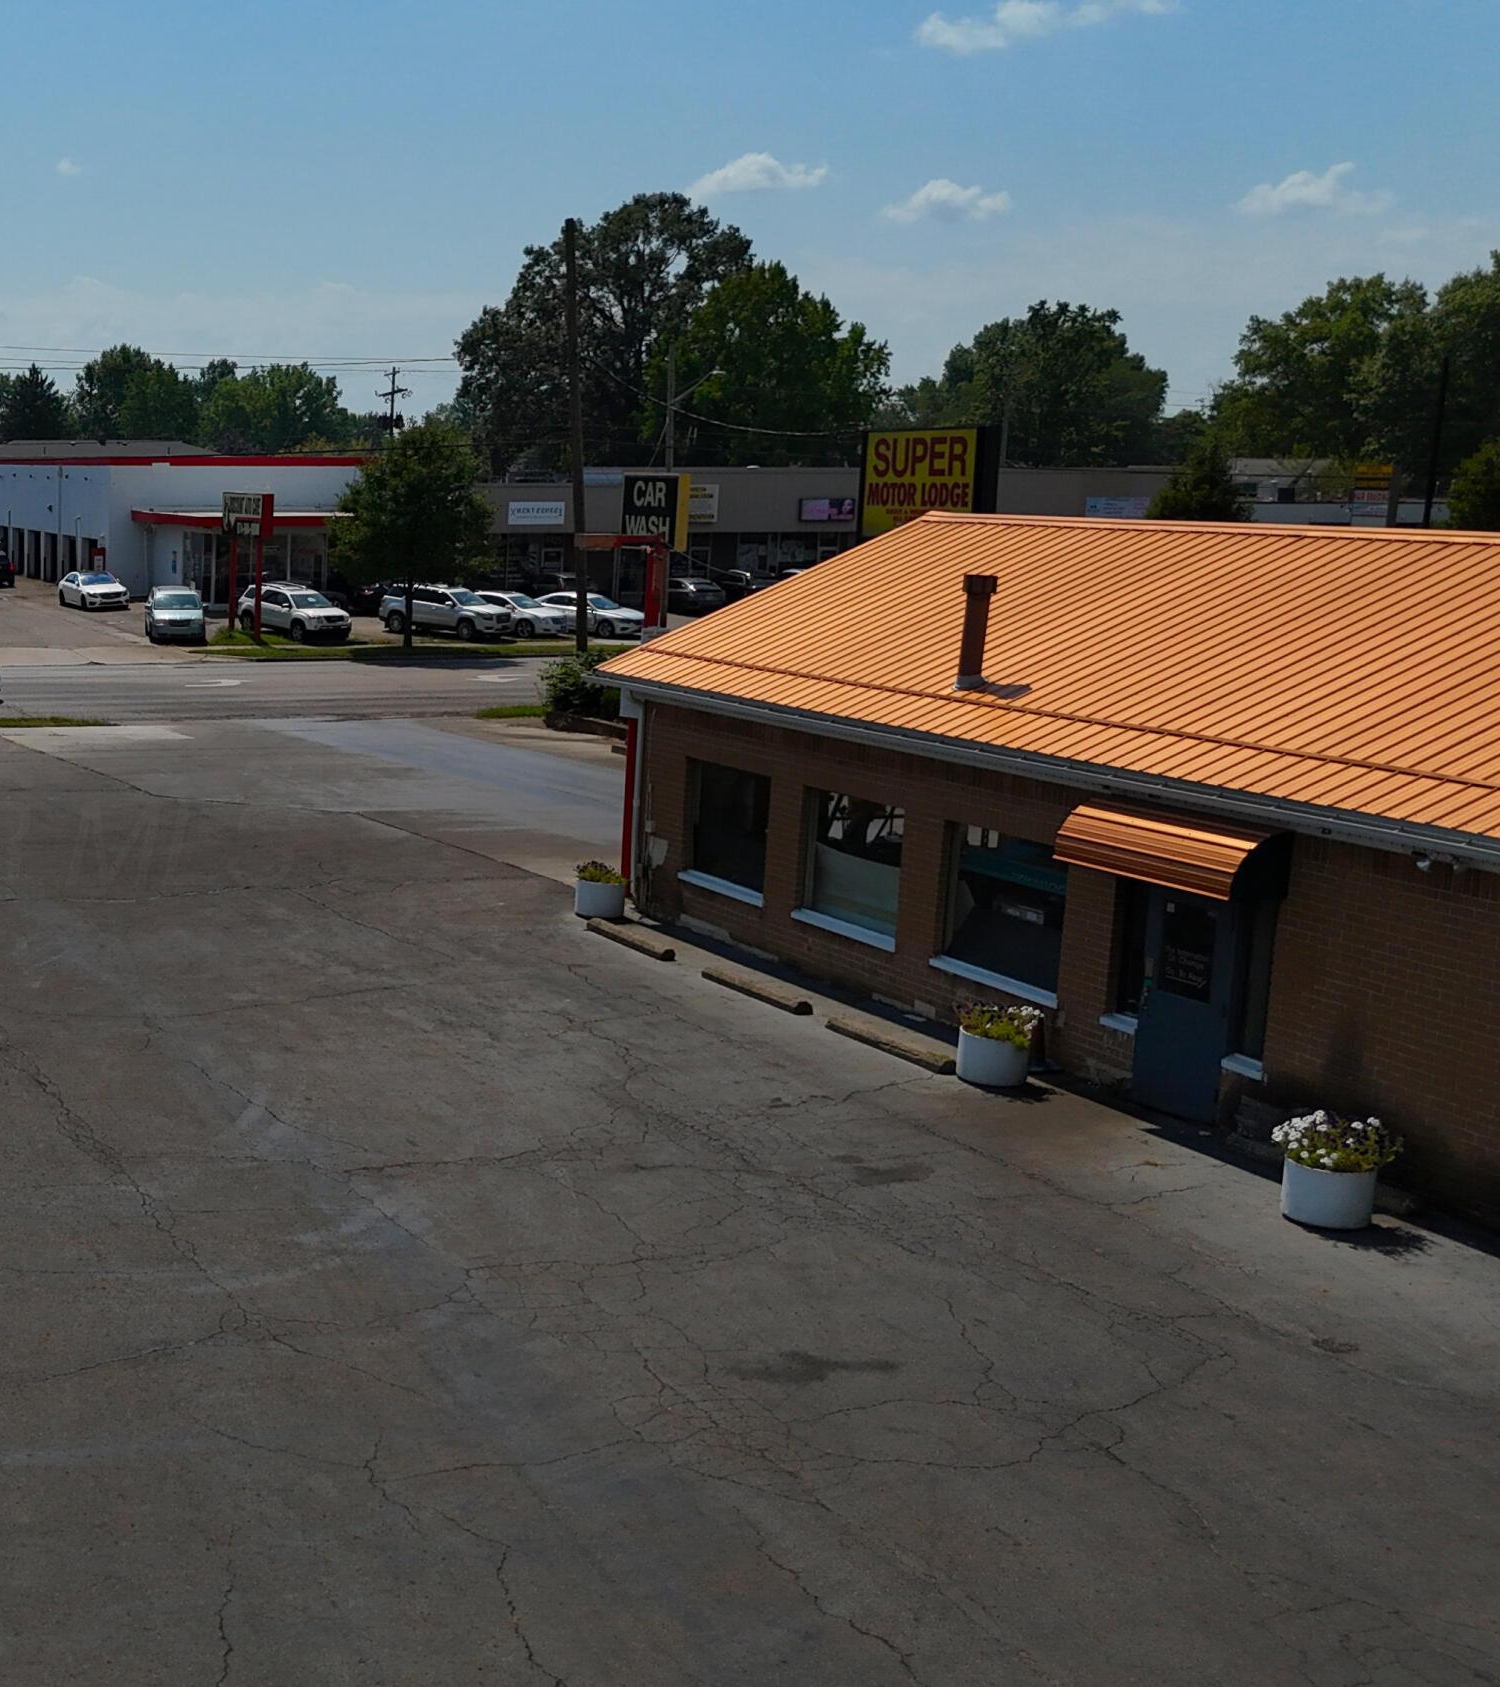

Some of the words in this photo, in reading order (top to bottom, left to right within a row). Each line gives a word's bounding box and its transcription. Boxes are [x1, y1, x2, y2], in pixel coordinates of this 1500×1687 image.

[873, 436, 968, 477] SUPER
[633, 480, 666, 507] CAR
[867, 482, 917, 507] MOTOR
[921, 482, 969, 508] LODGE
[625, 515, 670, 543] WASH
